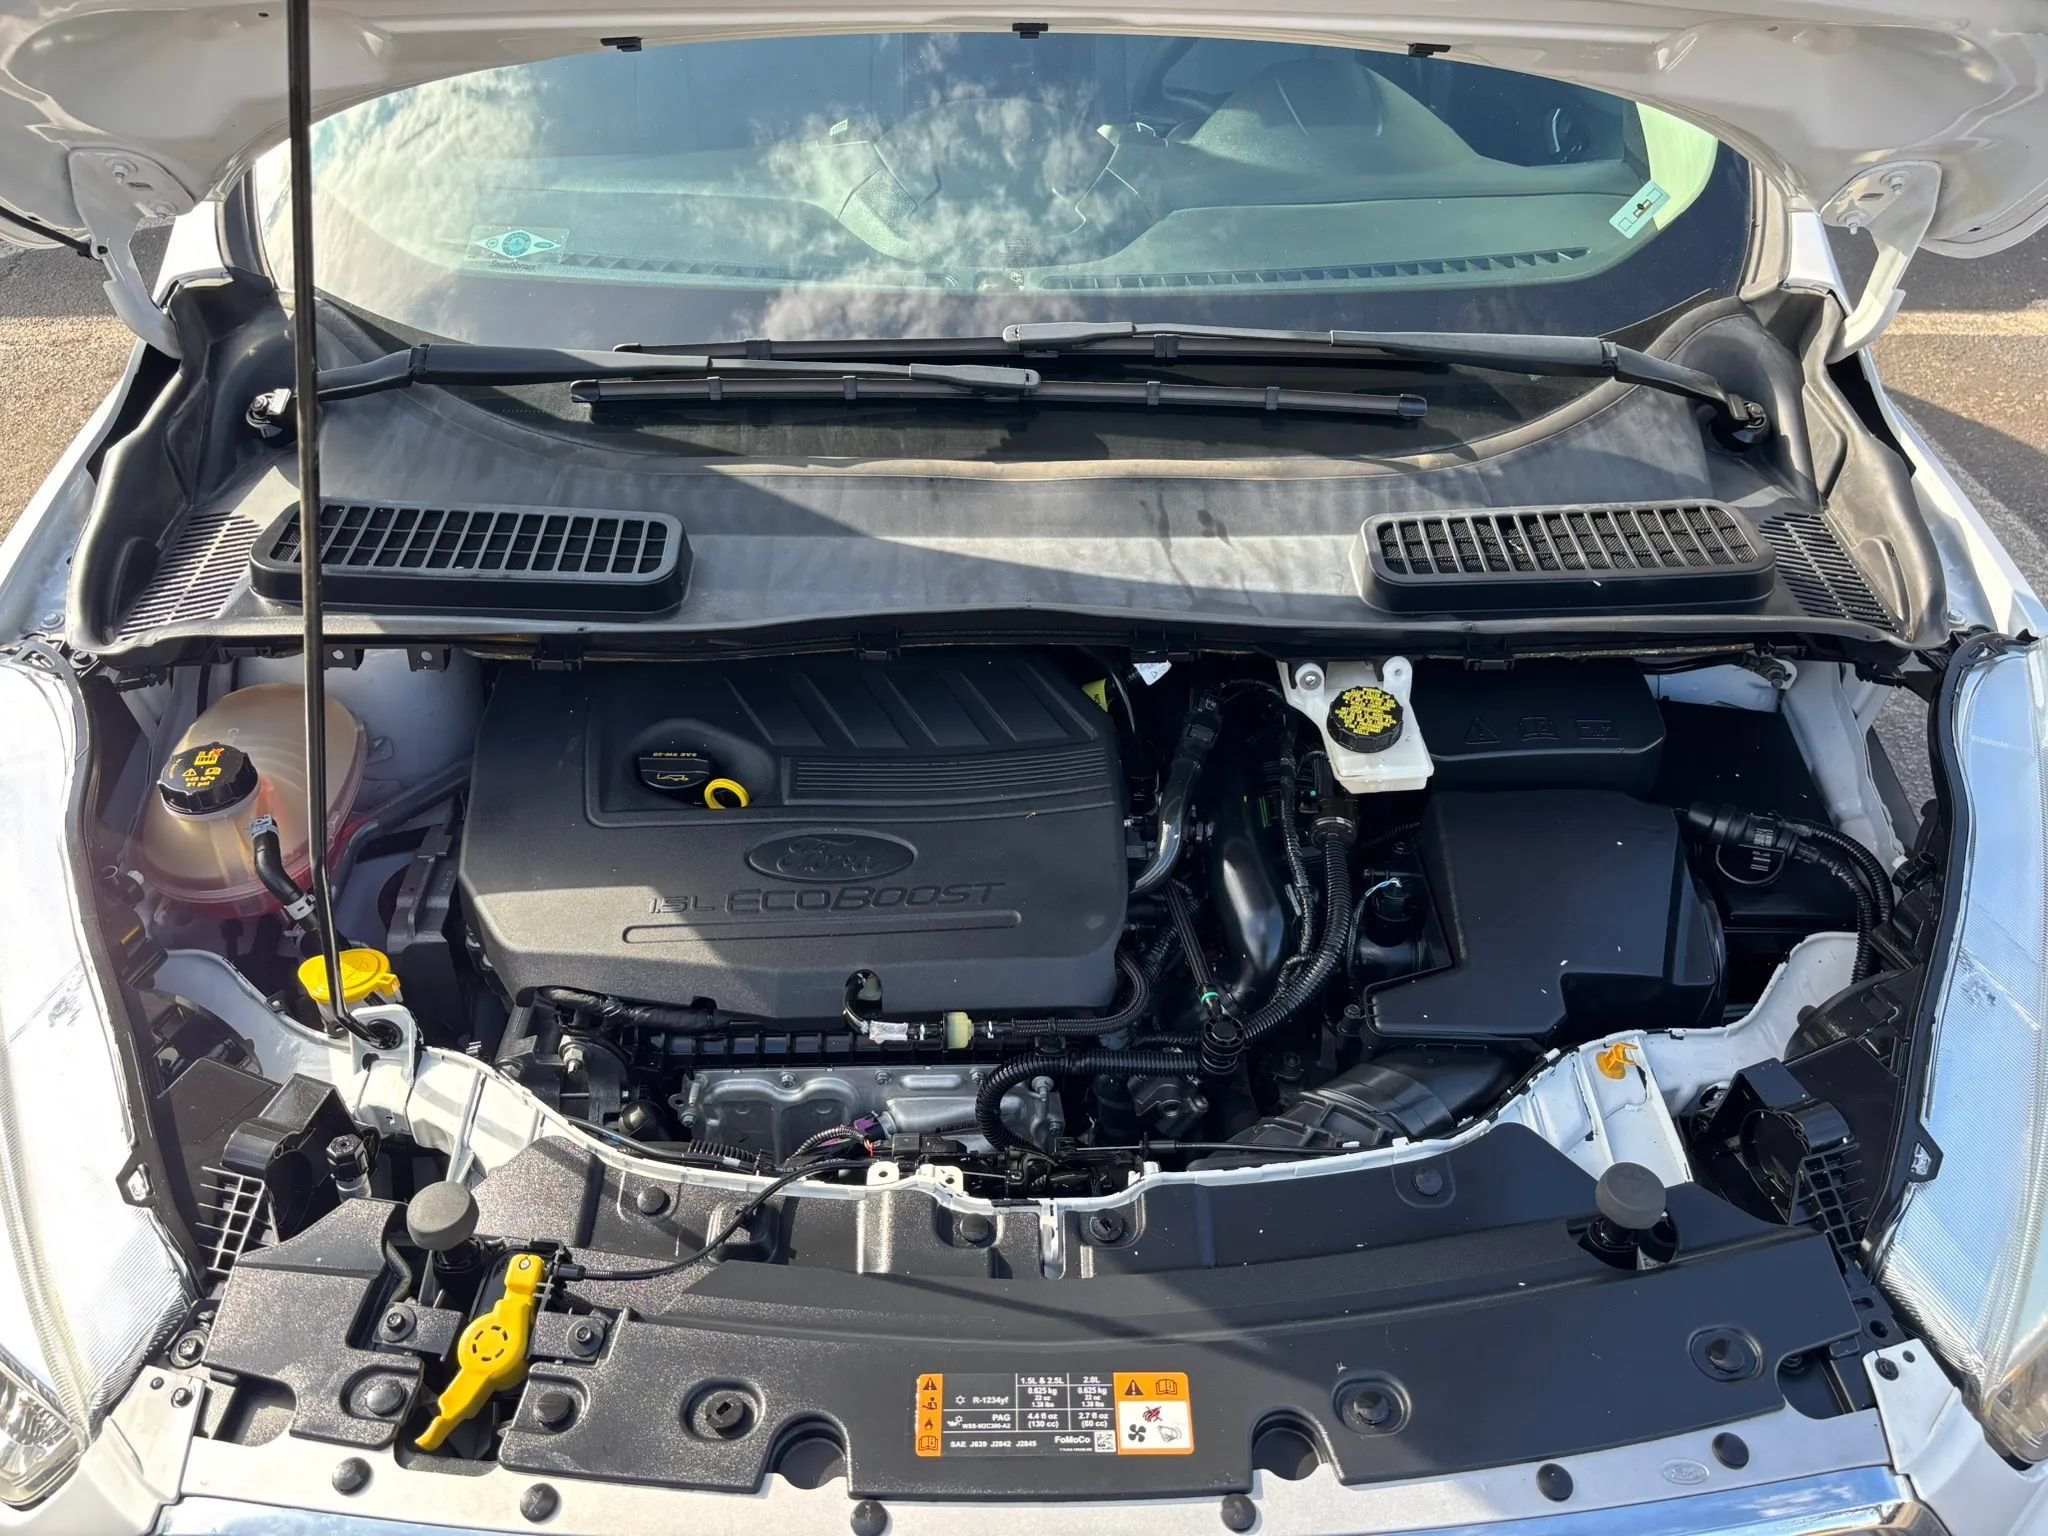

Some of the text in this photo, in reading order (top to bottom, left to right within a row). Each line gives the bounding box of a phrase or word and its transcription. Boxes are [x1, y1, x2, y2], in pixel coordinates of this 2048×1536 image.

[776, 837, 888, 873] Ford
[651, 895, 715, 914] 1.5L
[1048, 1387, 1058, 1396] kg
[1097, 1387, 1107, 1395] kg
[972, 1396, 1009, 1405] R-1234yf
[1028, 1420, 1045, 1429] (130
[1095, 1420, 1108, 1428] cc)
[1054, 1435, 1091, 1444] FoMoCo
